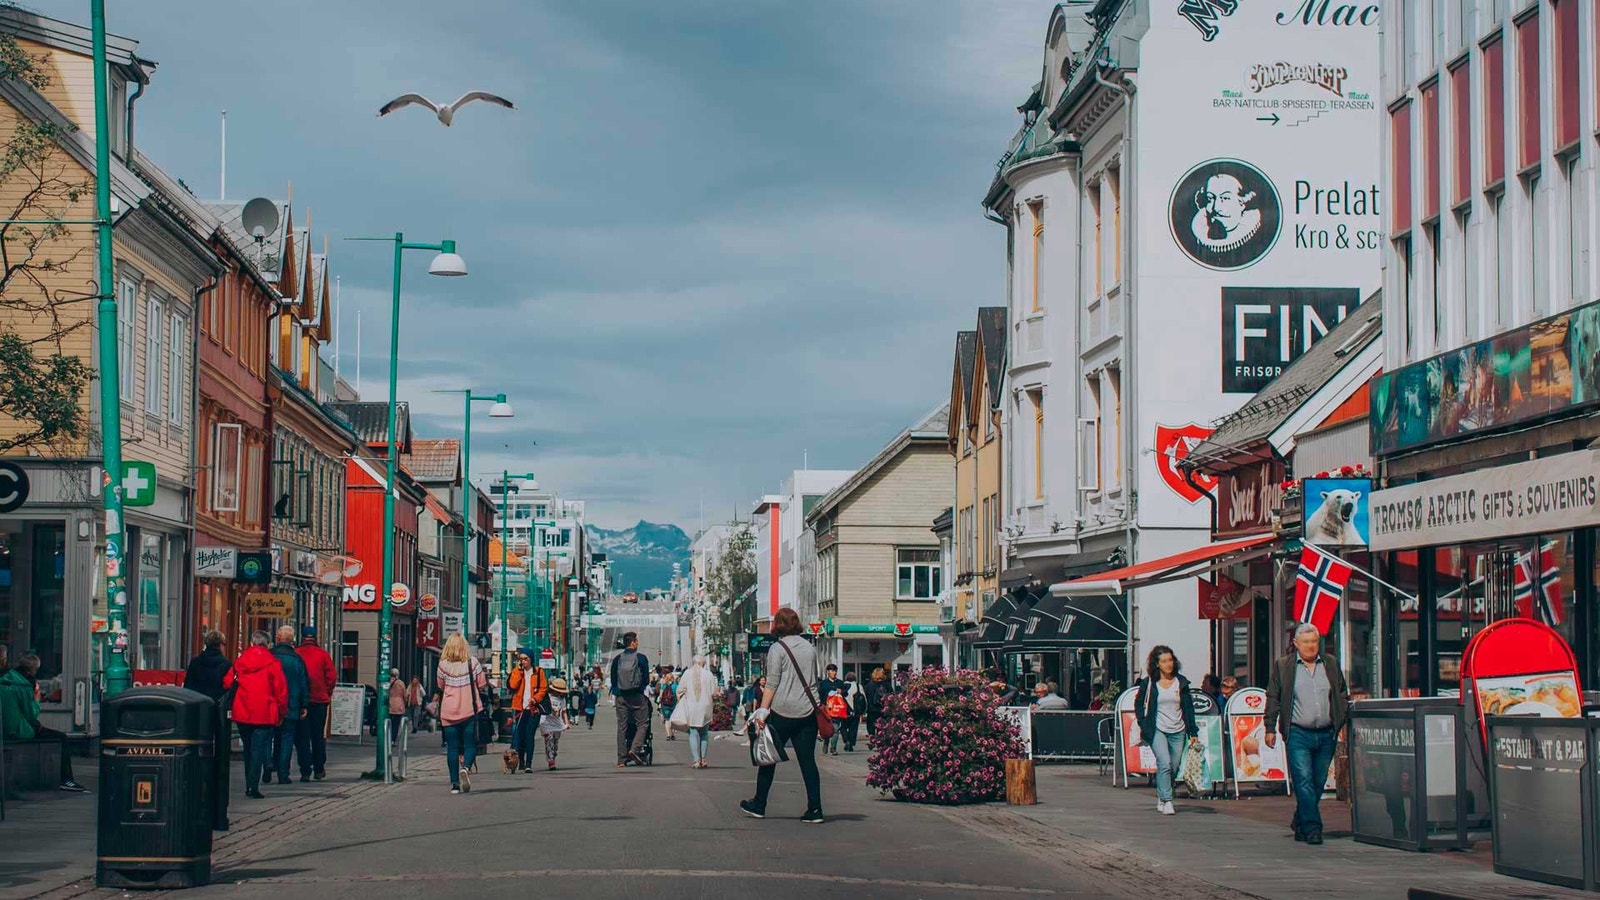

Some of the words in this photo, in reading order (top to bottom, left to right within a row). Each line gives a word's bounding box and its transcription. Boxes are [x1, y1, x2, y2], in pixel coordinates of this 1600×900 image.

[1275, 0, 1379, 26] Mac
[1295, 224, 1329, 249] Kro
[1336, 224, 1349, 249] &
[1374, 496, 1422, 534] TROMSØ
[1427, 489, 1476, 527] ARCTIC
[1482, 490, 1514, 521] GIFTS
[1526, 475, 1596, 515] SOUVENIRS
